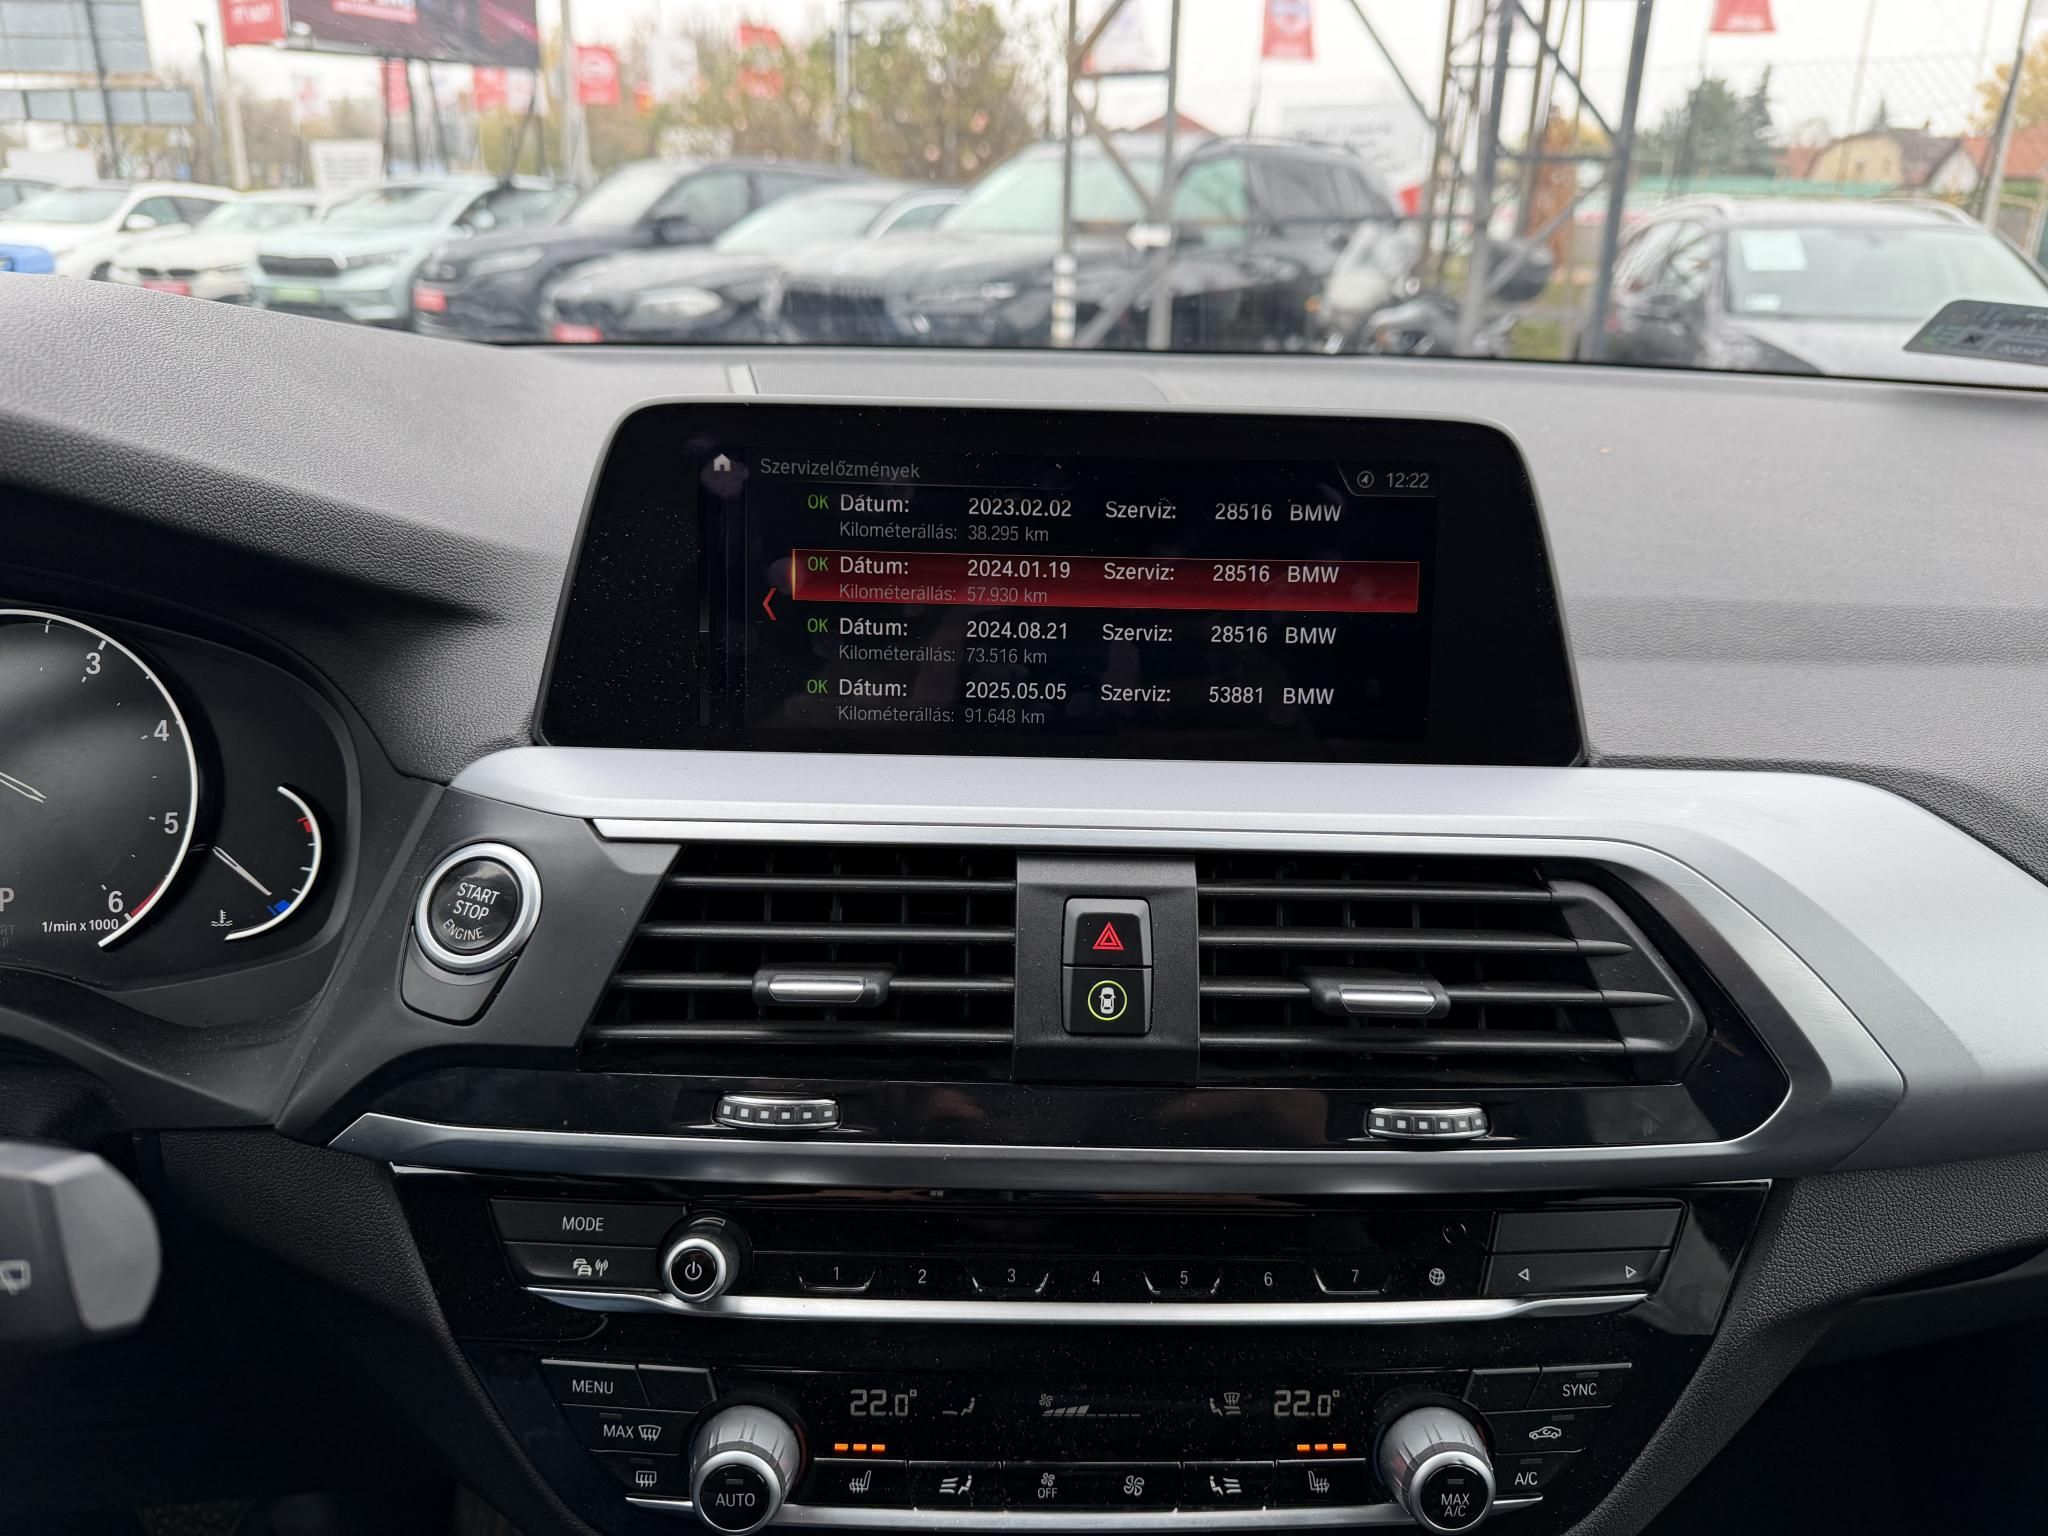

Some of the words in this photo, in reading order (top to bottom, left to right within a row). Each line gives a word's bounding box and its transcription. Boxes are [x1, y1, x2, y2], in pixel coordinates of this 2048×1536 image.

[760, 458, 920, 481] Szervizelőzmények
[1386, 472, 1430, 489] 12:22
[807, 494, 829, 510] OK
[840, 494, 909, 513] Dátum:
[968, 498, 1072, 517] 2023.02.02
[1105, 500, 1177, 520] Szerviz:
[1215, 503, 1272, 521] 28516
[1290, 504, 1342, 522] BMW
[839, 521, 957, 541] Kilométerállás:
[967, 525, 1019, 542] 38.295
[1025, 526, 1049, 542] km
[807, 556, 829, 572] OK
[839, 555, 909, 575] Dátum:
[967, 559, 1071, 579] 2024.01.19
[1104, 562, 1175, 581] Szerviz:
[1213, 564, 1270, 583] 28516
[1287, 566, 1339, 584] BMW
[839, 583, 957, 602] Kilométerállás:
[967, 587, 1019, 603] 57.930
[1024, 588, 1048, 604] km
[807, 618, 829, 633] OK
[839, 617, 908, 637] Dátum:
[966, 621, 1068, 640] 2024.08.21
[1102, 623, 1173, 643] Szerviz:
[1211, 626, 1268, 644] 28516
[1285, 627, 1337, 645] BMW
[838, 645, 956, 663] Kilométerállás:
[966, 648, 1018, 664] 73.516
[1023, 649, 1047, 665] km
[85, 653, 101, 675] 3
[807, 679, 828, 694] OK
[839, 678, 908, 698] Dátum:
[965, 681, 1067, 700] 2025.05.05
[1100, 684, 1172, 703] Szerviz:
[1209, 687, 1264, 704] 53881
[1283, 688, 1335, 705] BMW
[838, 705, 955, 723] Kilométerállás:
[964, 708, 1017, 725] 91.648
[1021, 709, 1045, 725] km
[153, 720, 169, 740] 4
[164, 812, 179, 834] 5
[108, 890, 124, 913] 6
[457, 882, 500, 905] START
[453, 900, 489, 920] STOP
[42, 920, 77, 933] 1/min
[79, 922, 87, 931] x
[88, 918, 119, 931] 1000
[443, 918, 484, 940] ENGINE
[562, 1216, 604, 1232] MODE
[833, 1266, 840, 1281] 1
[918, 1269, 927, 1284] 2
[1007, 1268, 1016, 1283] 3
[1092, 1270, 1101, 1285] 4
[1180, 1270, 1189, 1285] 5
[1264, 1272, 1273, 1287] 6
[1351, 1269, 1360, 1284] 7
[572, 1379, 614, 1395] MENU
[1562, 1382, 1597, 1397] SYNC
[603, 1424, 634, 1439] MAX
[1514, 1471, 1538, 1486] A/C
[716, 1492, 755, 1507] AUTO
[1038, 1487, 1058, 1499] OFF
[1441, 1492, 1470, 1507] MAX
[1443, 1505, 1466, 1518] A/C
